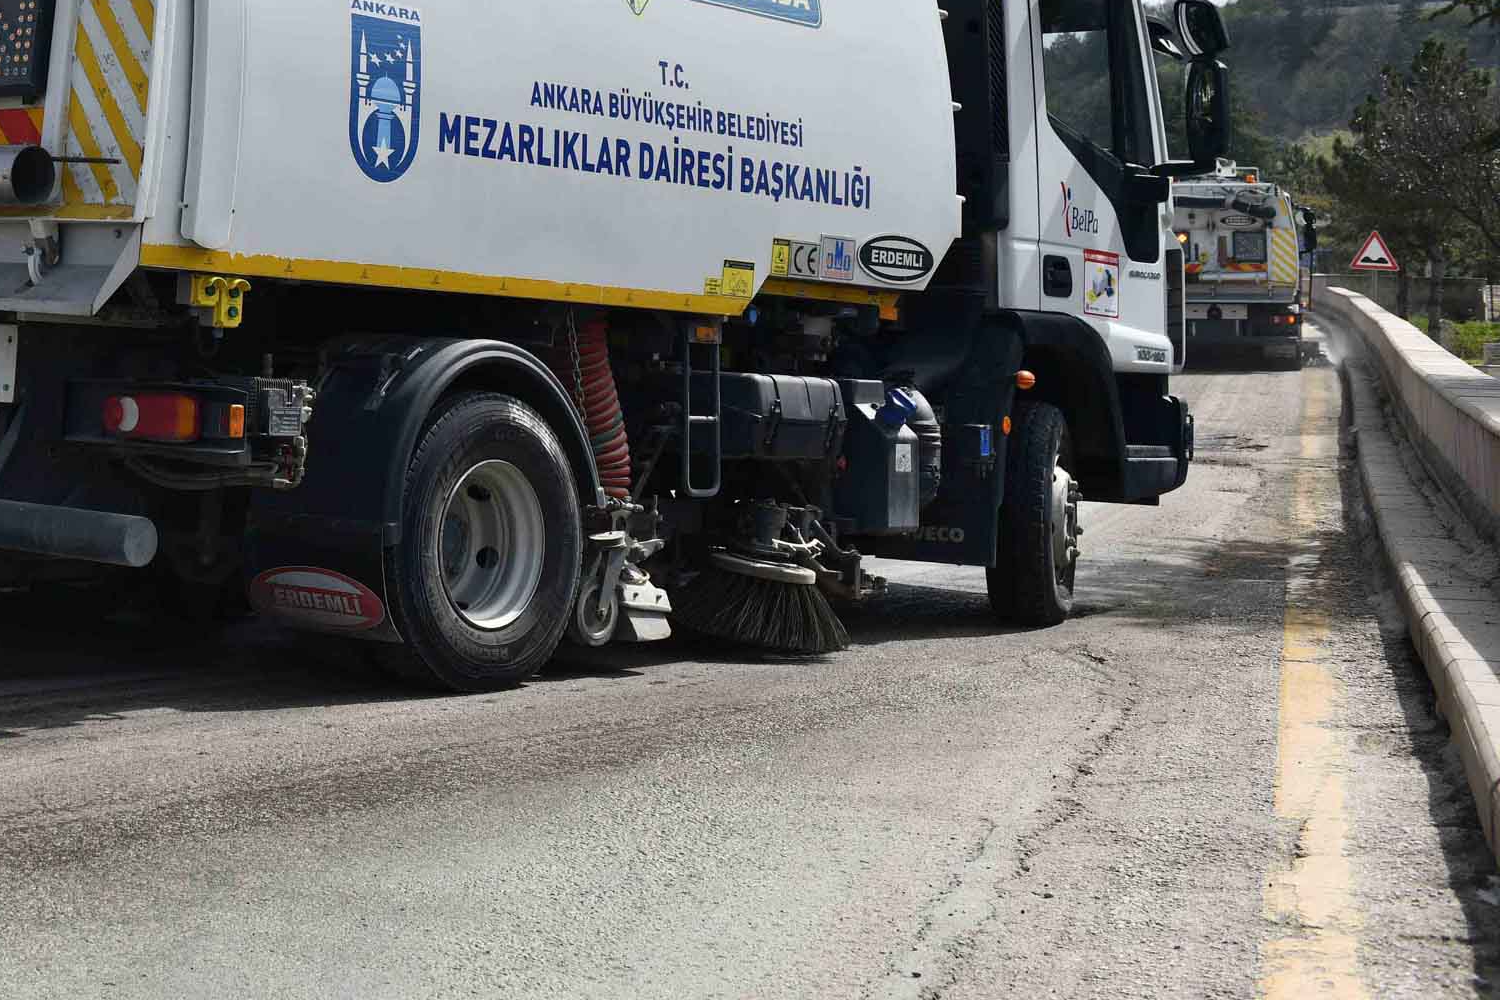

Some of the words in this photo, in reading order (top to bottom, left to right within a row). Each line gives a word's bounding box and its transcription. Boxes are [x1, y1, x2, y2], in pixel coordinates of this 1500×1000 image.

[658, 61, 690, 90] T.C.
[530, 81, 604, 116] ANKARA
[609, 88, 714, 134] BÜYÜKŞEHİR
[716, 110, 803, 148] BELEDİYESİ
[438, 112, 631, 178] MEZARLIKLAR
[638, 136, 734, 191] DAİRESİ
[740, 156, 871, 210] BAŞKANLIĞI
[1071, 206, 1099, 234] BelPa
